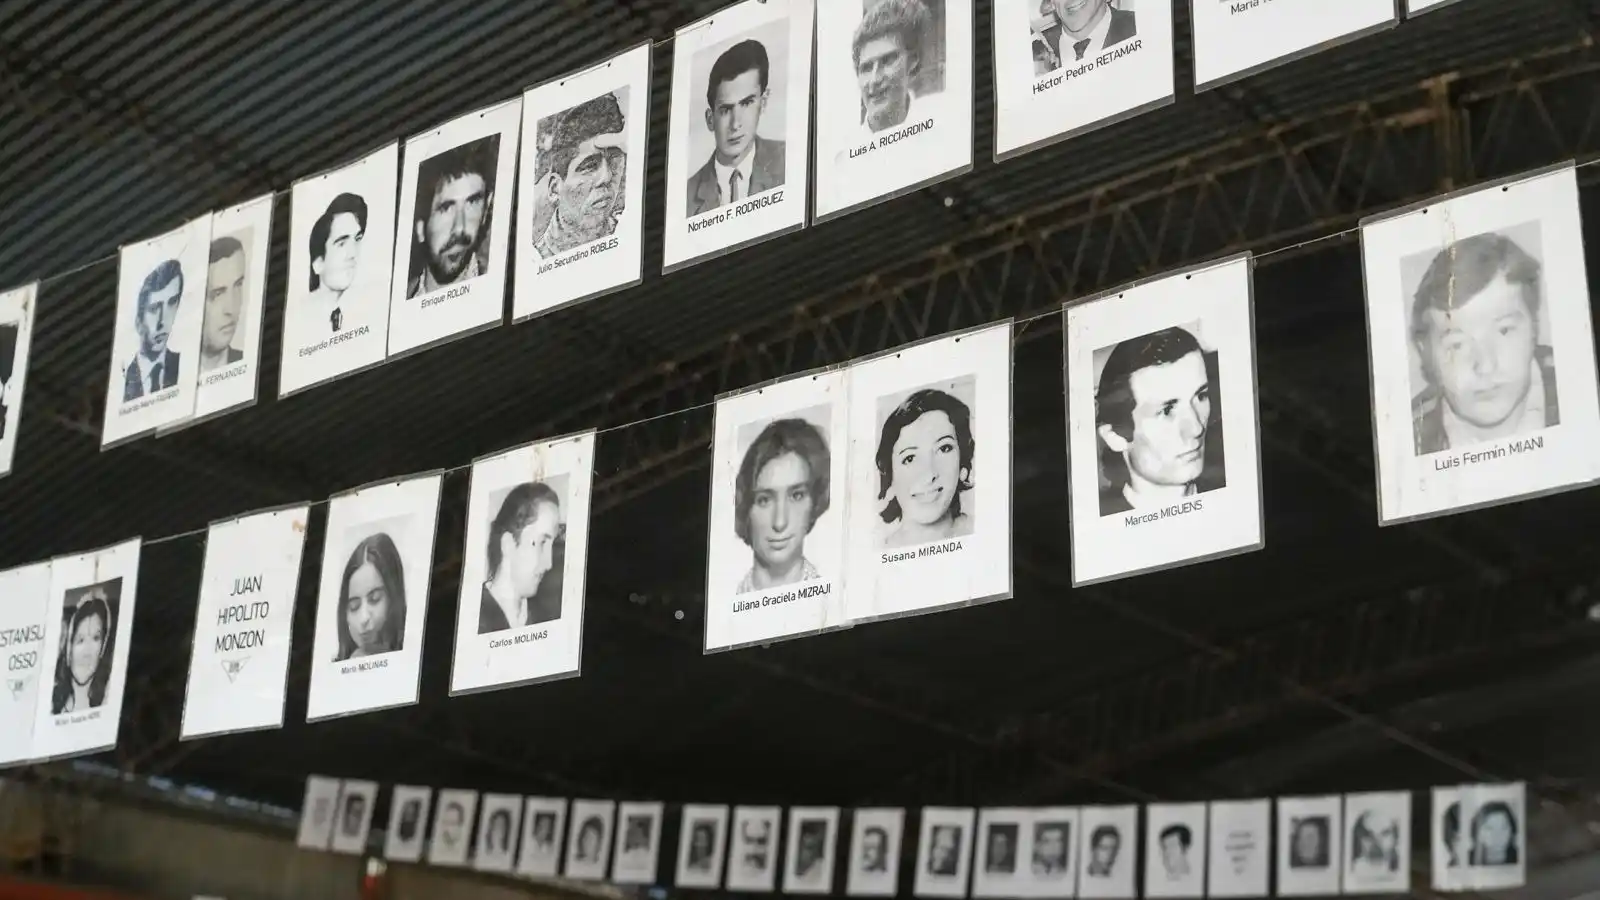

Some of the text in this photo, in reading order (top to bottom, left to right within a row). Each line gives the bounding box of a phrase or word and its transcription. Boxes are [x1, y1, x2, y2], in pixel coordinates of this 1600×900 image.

[1032, 39, 1143, 96] Héctor Pedro RETAMAR
[849, 144, 868, 159] Luis
[879, 118, 934, 148] RICCIARDINO
[688, 190, 784, 234] Norberto F. RODRIGUEZ
[536, 238, 619, 276] Julio Secundino ROBLES
[421, 284, 471, 309] Enrique ROLON
[299, 325, 370, 357] Edgardo FERREYRA
[206, 364, 248, 385] FERNANDEZ
[1435, 436, 1545, 472] Luis Fermín MIANI
[1125, 499, 1204, 528] Marcos MIGUENS
[881, 540, 963, 564] Susana MIRANDA
[230, 573, 262, 597] JUAN
[733, 582, 831, 613] Liliana Graciela MIZRAJI
[217, 601, 270, 626] HIPOLITO
[214, 629, 265, 654] MONZON
[489, 630, 548, 649] Carlos MOLINAS
[8, 650, 37, 671] OSSO
[358, 658, 389, 671] MOLINAS
